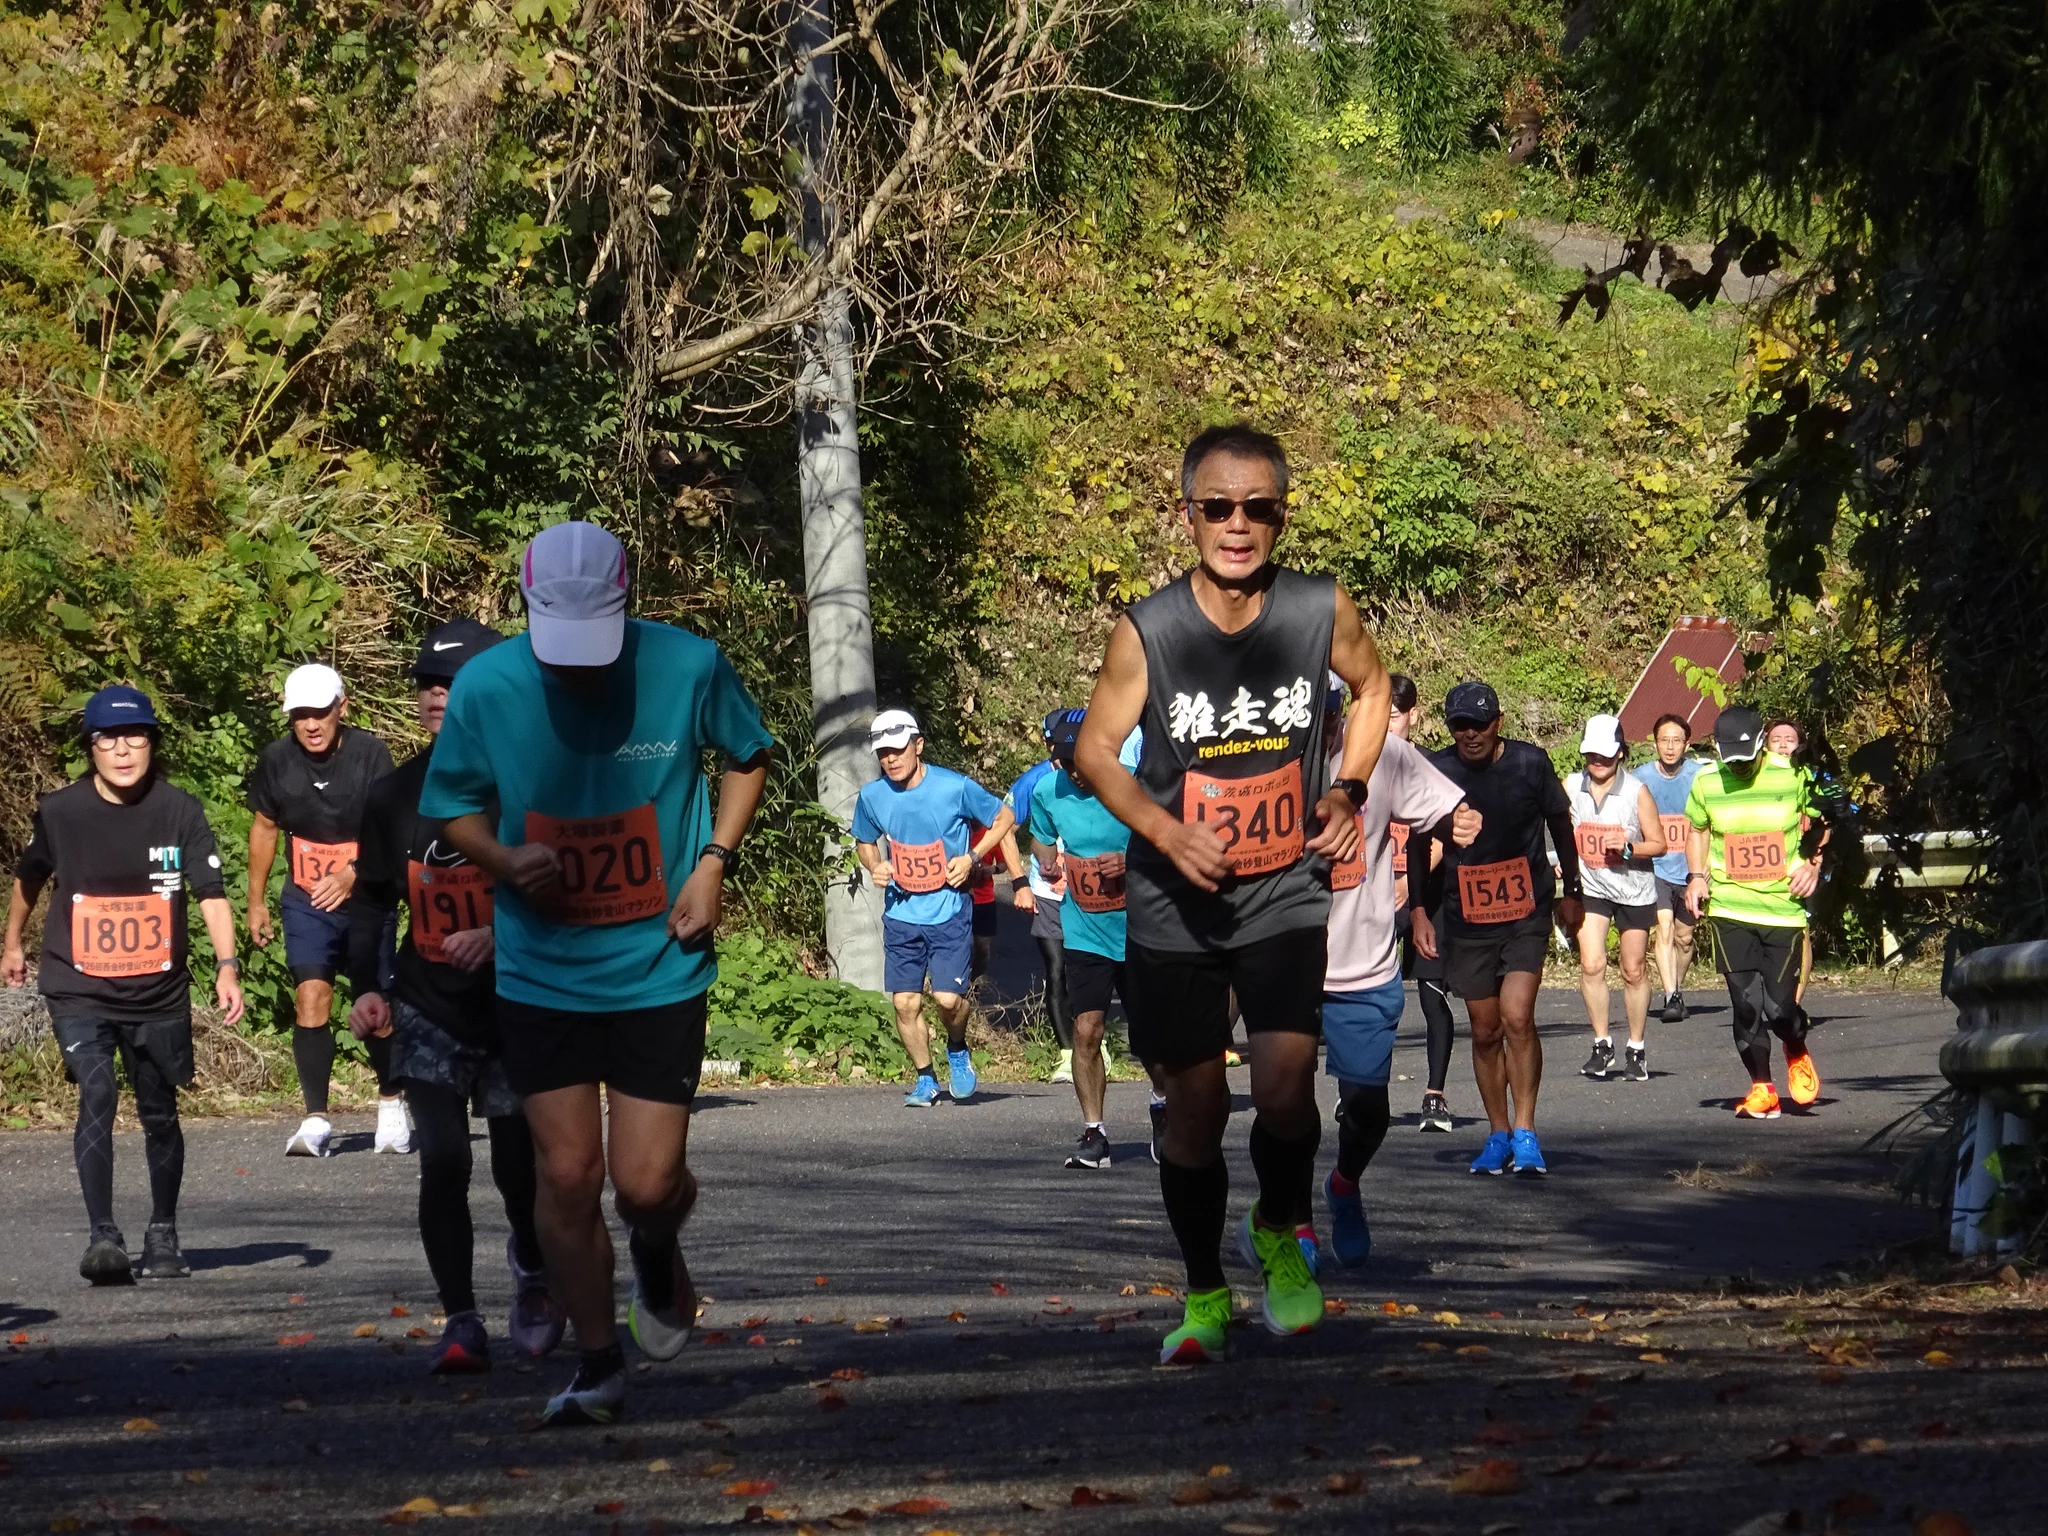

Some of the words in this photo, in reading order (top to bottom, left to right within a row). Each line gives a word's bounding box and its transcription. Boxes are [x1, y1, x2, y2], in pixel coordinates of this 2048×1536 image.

[1198, 736, 1290, 759] rendez-vous
[1197, 792, 1295, 854] 1340
[895, 853, 943, 879] 1355
[1729, 844, 1781, 869] 1350
[1466, 874, 1527, 908] 1543
[83, 915, 162, 955] 1803
